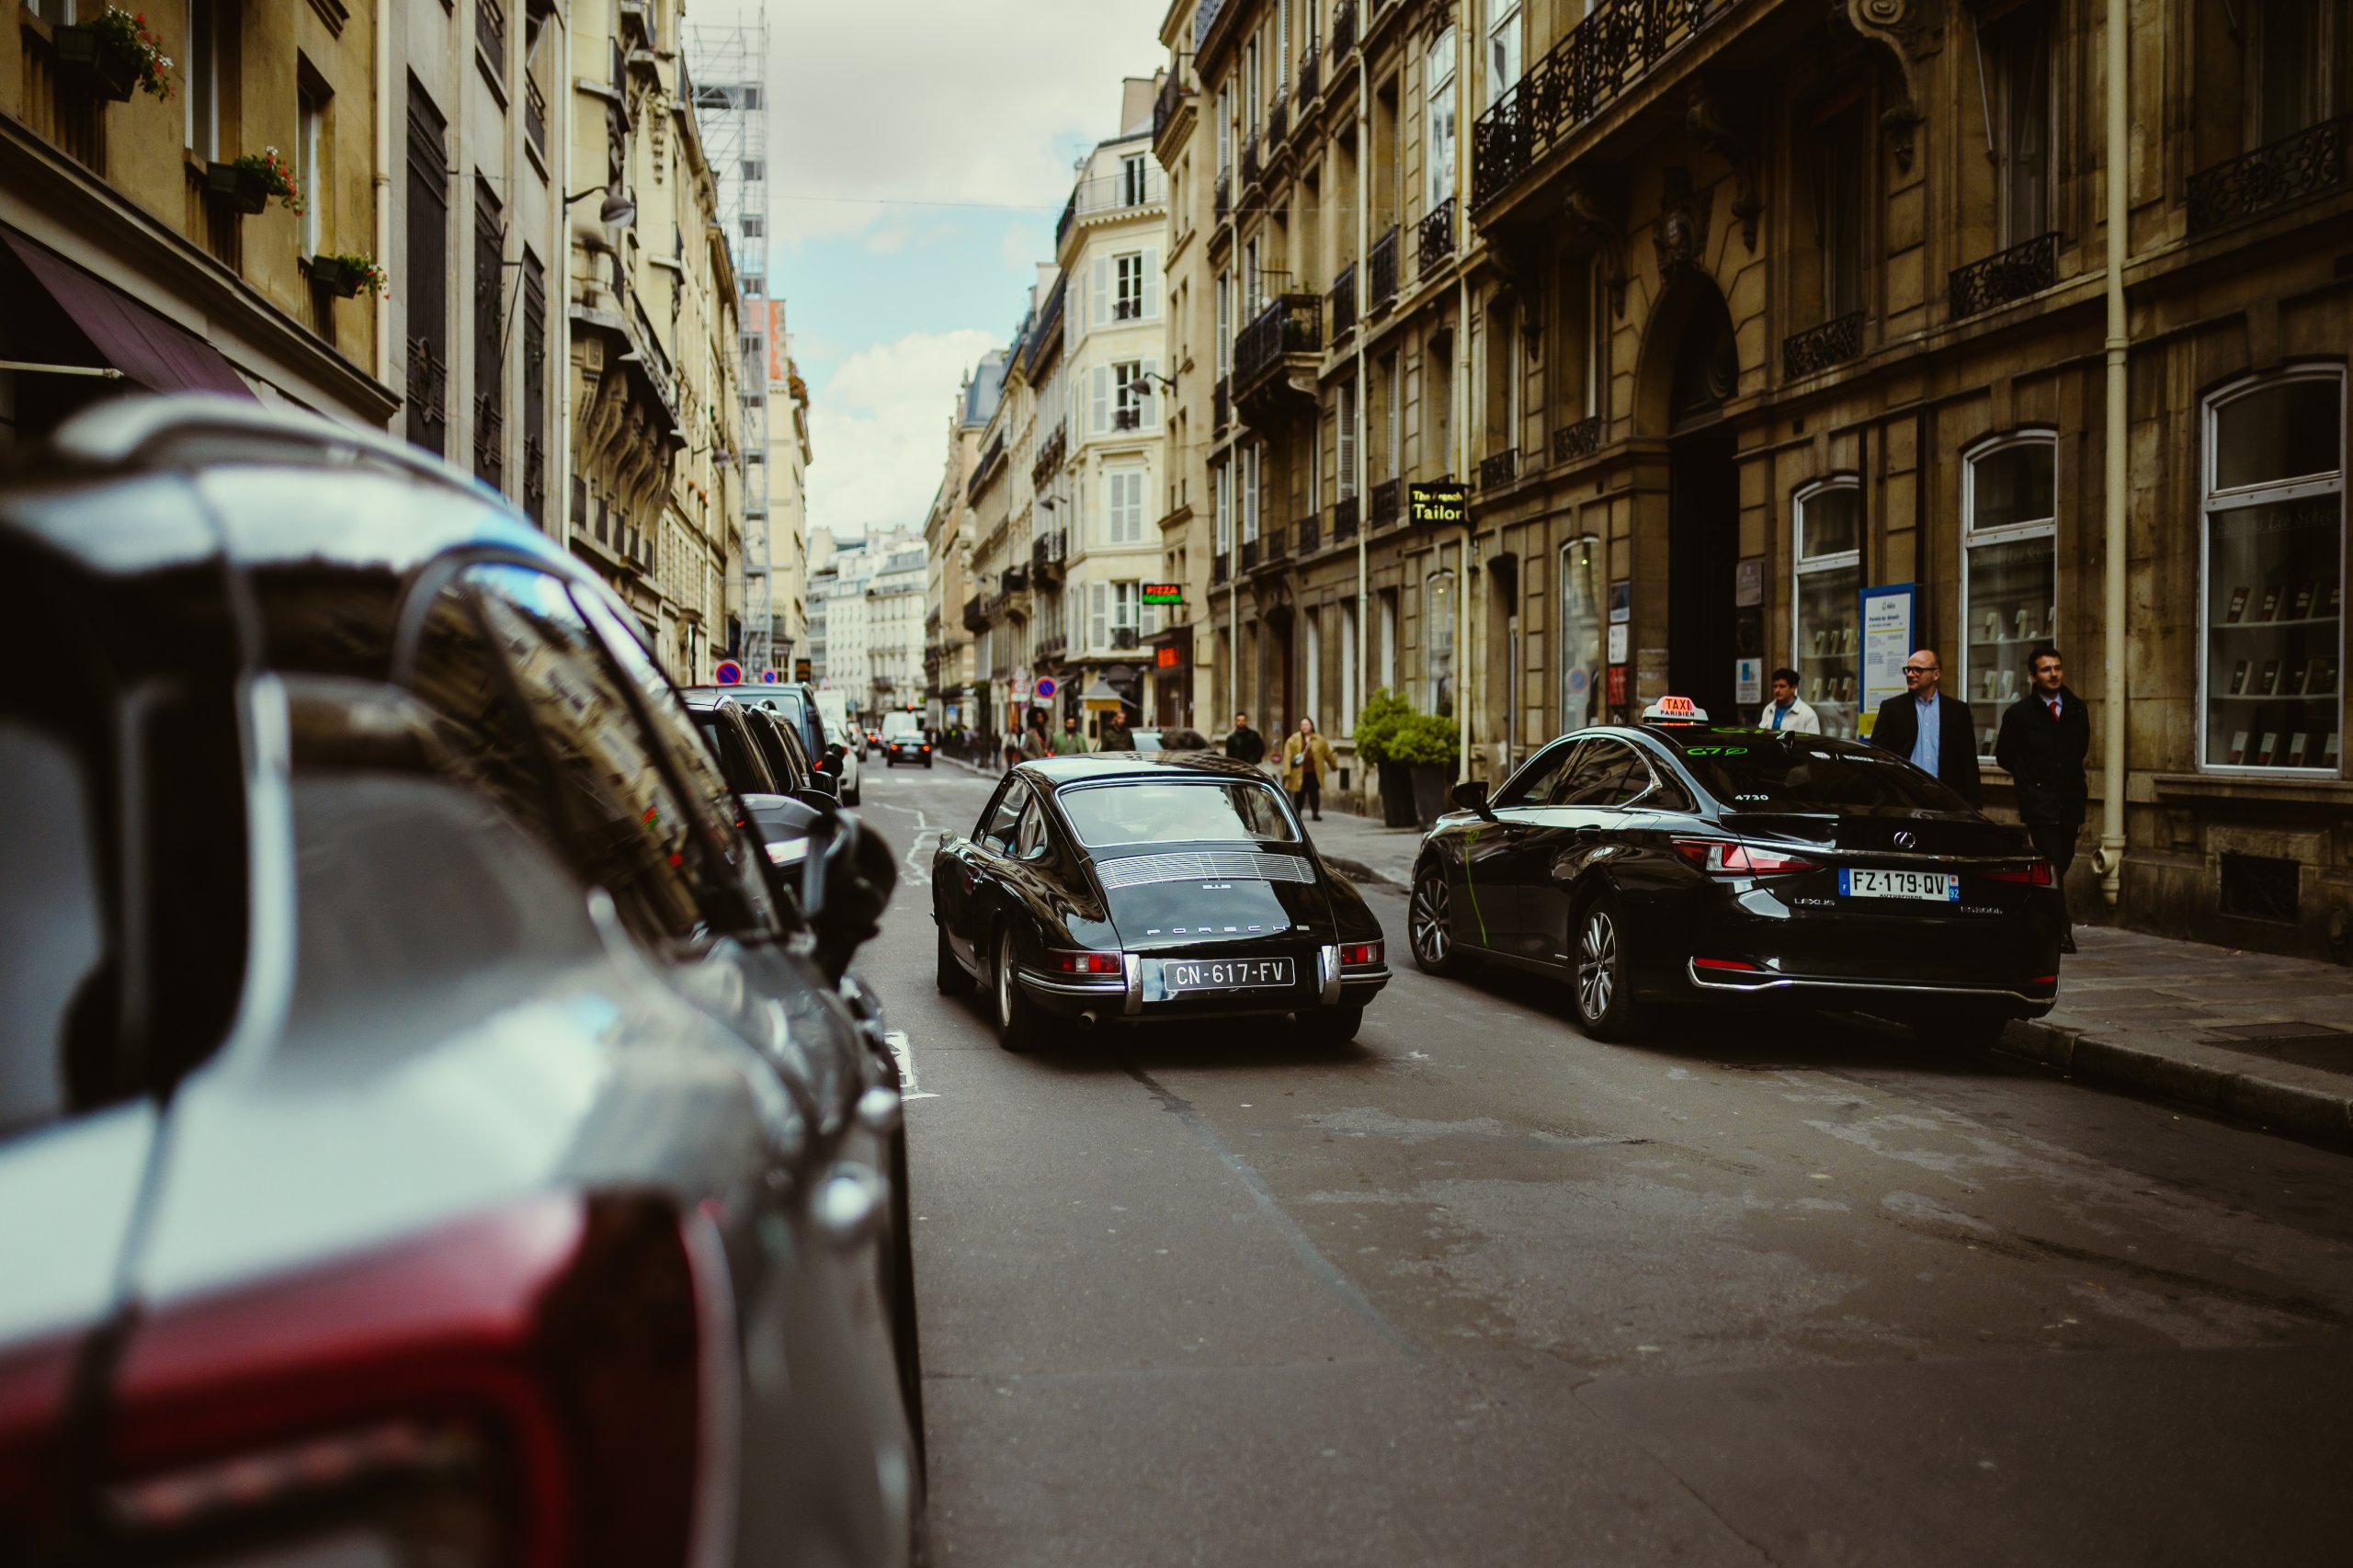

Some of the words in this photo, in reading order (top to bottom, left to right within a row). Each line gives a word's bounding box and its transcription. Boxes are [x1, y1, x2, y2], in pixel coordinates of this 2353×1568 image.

[1412, 490, 1431, 501] The
[1412, 503, 1463, 521] Tailor
[1146, 585, 1178, 596] PIZZA
[1665, 699, 1690, 710] TAXI
[1734, 794, 1770, 802] 4730
[1853, 871, 1945, 895] FZ-179-QV
[1949, 888, 1960, 900] 92
[1793, 898, 1836, 906] LEXUS
[1146, 925, 1311, 936] PORSCHE
[1175, 961, 1284, 986] CN-617-FV
